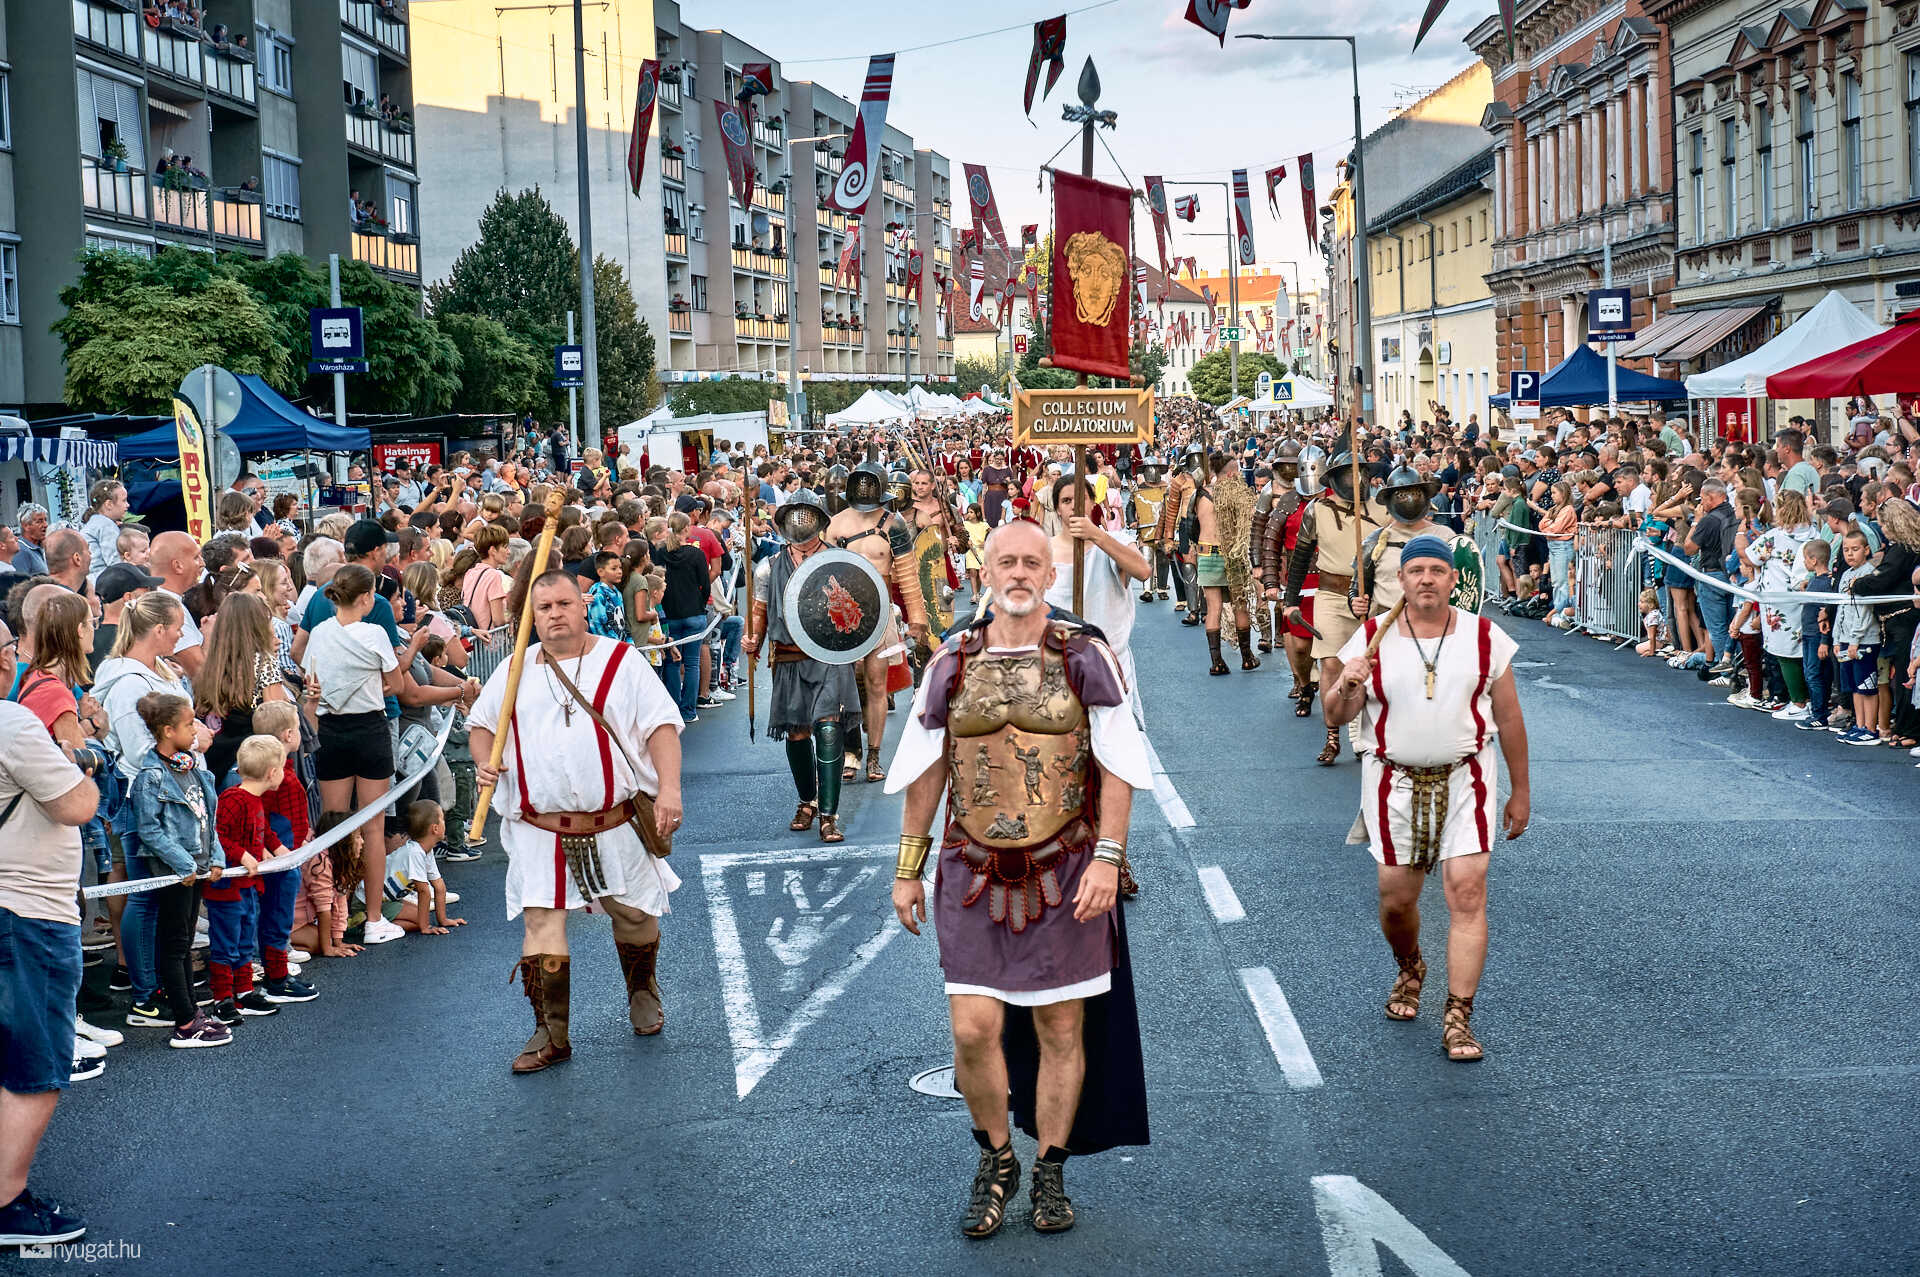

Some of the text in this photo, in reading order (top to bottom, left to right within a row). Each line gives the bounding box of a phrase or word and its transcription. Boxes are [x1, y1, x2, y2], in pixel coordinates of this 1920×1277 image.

[319, 363, 355, 371] Városháza
[1517, 373, 1534, 398] P
[1042, 400, 1127, 416] COLLEGIUM
[1033, 418, 1135, 433] GLADIATORIUM
[384, 447, 431, 456] Hatalmas
